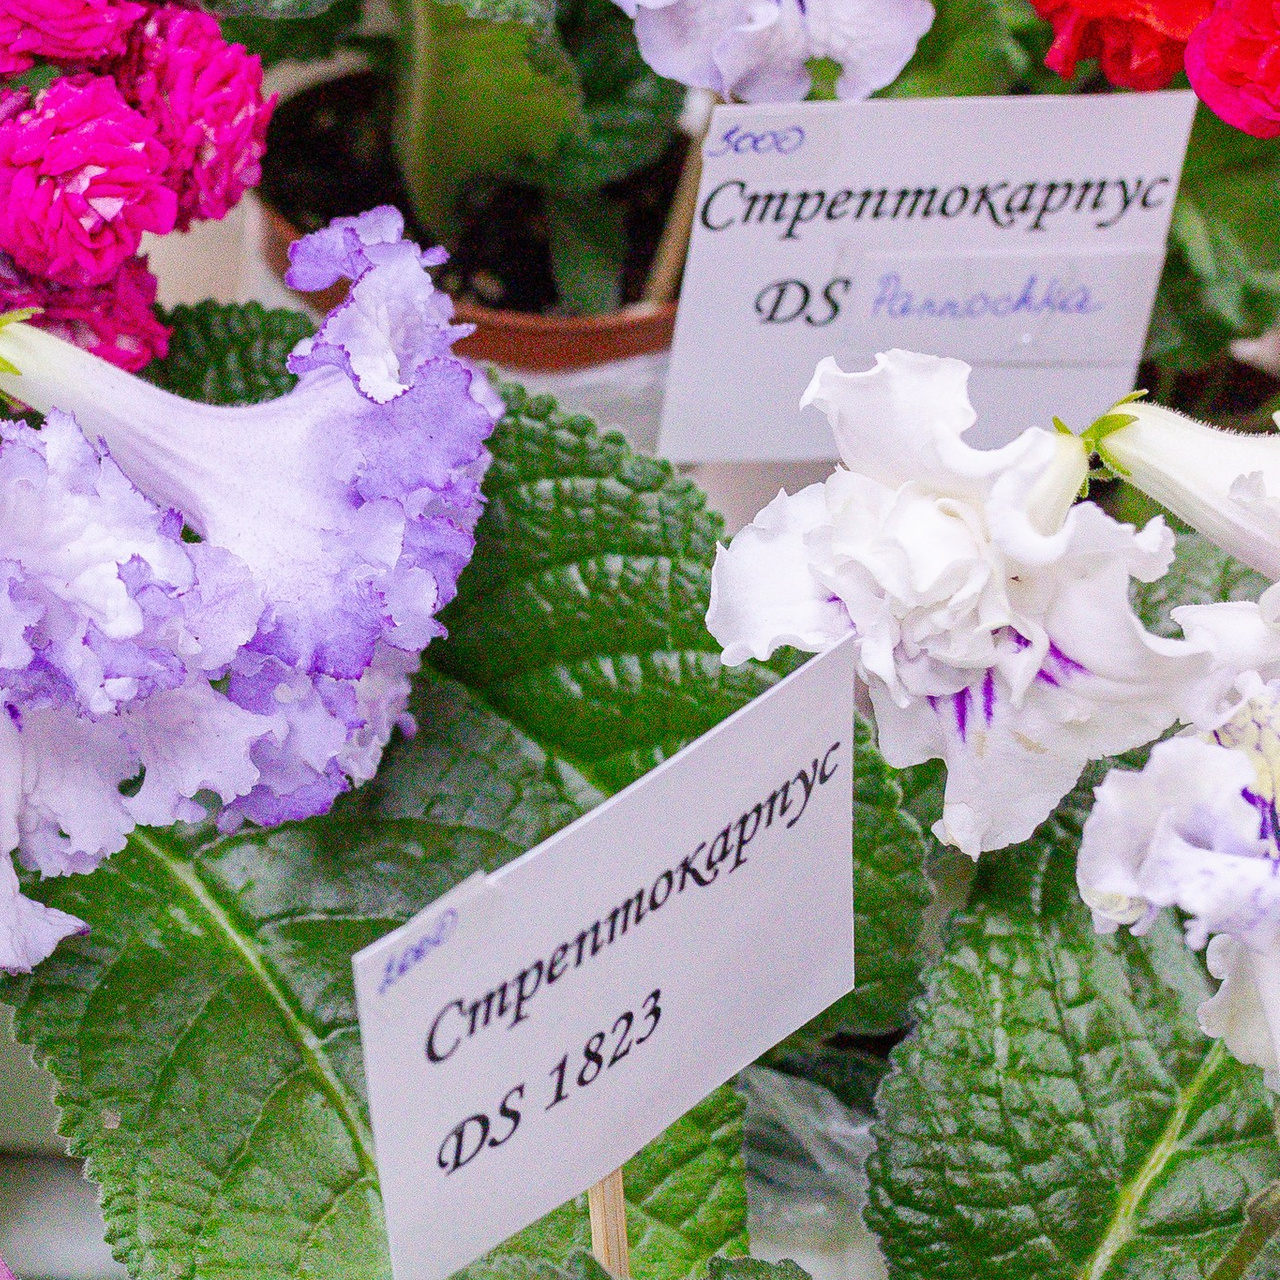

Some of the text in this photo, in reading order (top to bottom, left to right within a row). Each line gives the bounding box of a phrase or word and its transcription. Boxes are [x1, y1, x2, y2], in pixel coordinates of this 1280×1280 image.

[700, 174, 1170, 240] Стрептокарпус
[753, 276, 852, 327] DS
[425, 741, 840, 1065] Стрептокарпус
[437, 987, 664, 1177] DS 1823
